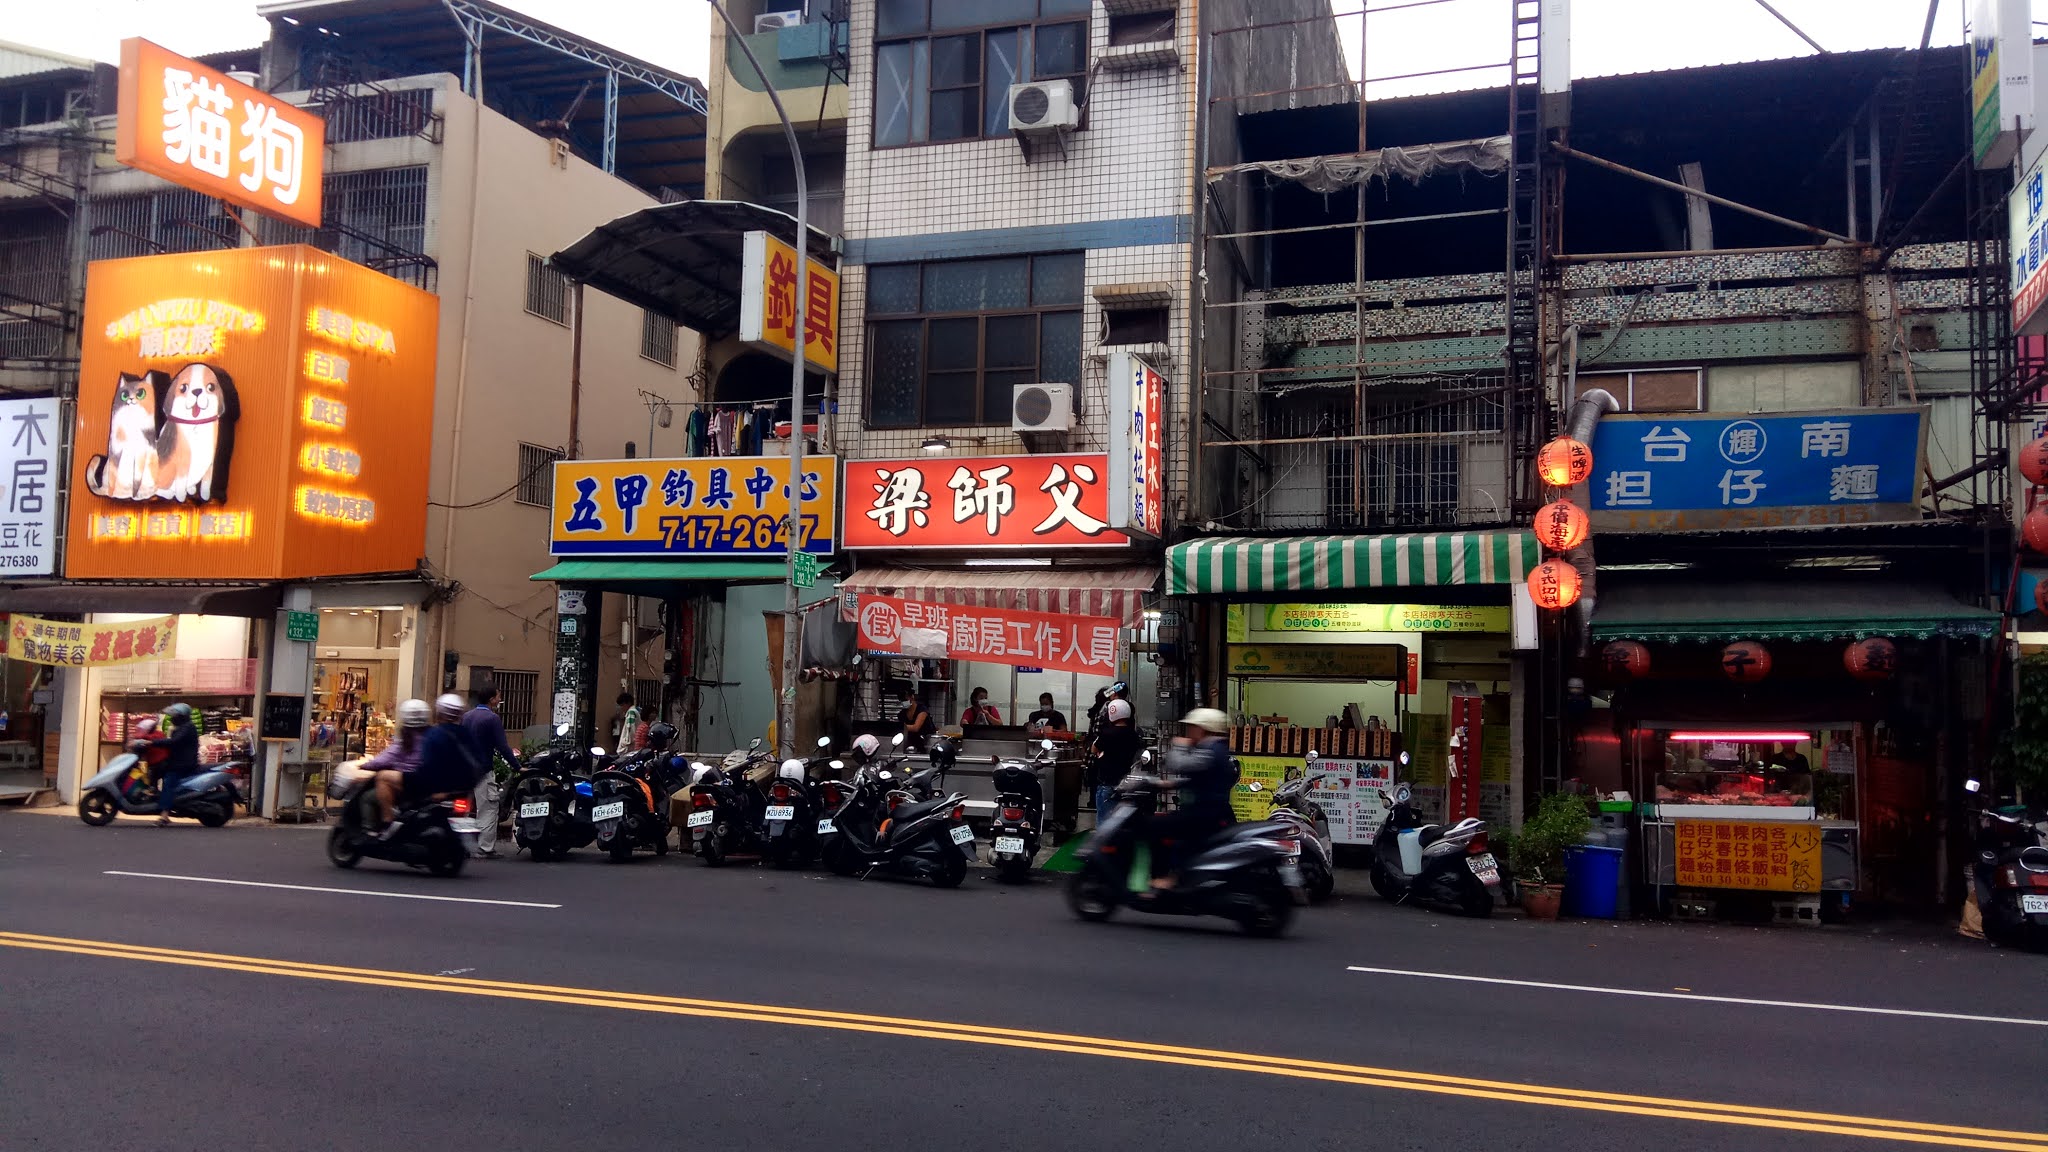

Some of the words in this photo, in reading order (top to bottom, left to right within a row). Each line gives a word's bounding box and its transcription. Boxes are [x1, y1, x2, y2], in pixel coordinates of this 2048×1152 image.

[163, 66, 302, 205] 貓狗
[766, 250, 834, 357] 釣具
[10, 404, 49, 513] 木居
[1147, 377, 1160, 534] 手工水餃
[1571, 446, 1587, 481] 生啤酒
[564, 467, 819, 534] 五甲釣具中心
[866, 463, 1109, 537] 梁師父
[1, 521, 43, 548] 豆花
[661, 515, 819, 549] 717-2647
[1550, 505, 1570, 547] 平價海產
[1541, 566, 1558, 604] 各式切料
[33, 623, 81, 641] 過年期間
[903, 602, 949, 629] 早班
[1403, 610, 1482, 619] 本店招牌寒天五合一
[24, 639, 87, 665] 寵物美容
[952, 613, 1115, 668] 廚房工作人員
[997, 842, 1022, 851] 555-PLA
[1715, 825, 1732, 874] 陽春麵
[1770, 827, 1788, 877] 各式切料
[1789, 831, 1820, 881] 炒飯
[1680, 874, 1695, 883] 30
[1698, 875, 1713, 884] 30
[1718, 875, 1732, 885] 30
[1736, 876, 1750, 886] 30
[1754, 877, 1768, 887] 20
